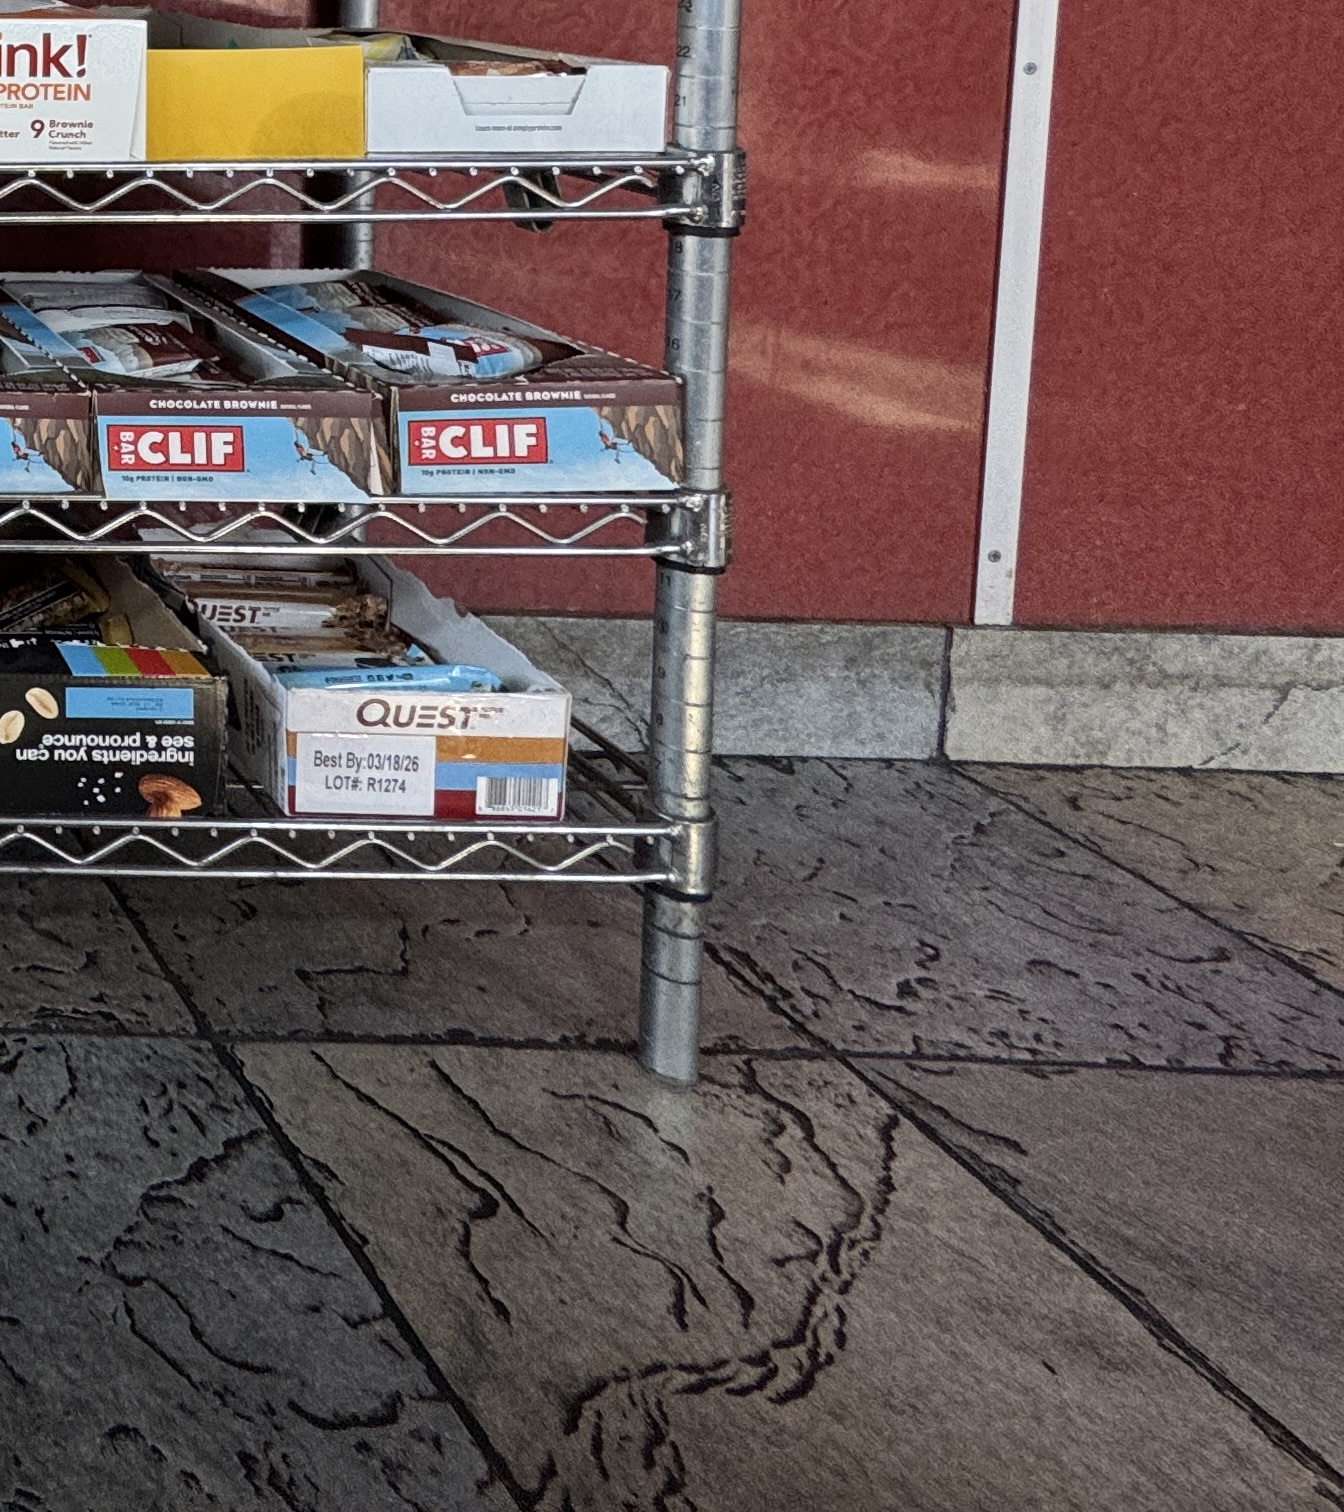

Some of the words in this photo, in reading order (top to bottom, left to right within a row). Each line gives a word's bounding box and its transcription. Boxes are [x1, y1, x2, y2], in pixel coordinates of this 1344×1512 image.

[677, 45, 690, 57] 22
[50, 120, 94, 129] Brownie
[49, 130, 86, 139] Crunch
[451, 392, 522, 403] CHOCOLATE
[525, 390, 582, 401] BROWNIE
[150, 400, 220, 409] CHOCOLATE
[224, 400, 278, 410] BROWNIE
[120, 432, 134, 464] BAR
[137, 432, 233, 465] CLIF
[421, 427, 436, 459] BAR
[439, 424, 537, 458] CLIF
[356, 698, 474, 730] QUEST
[43, 733, 140, 748] pronounce
[161, 734, 194, 746] see
[16, 748, 49, 761] can
[54, 748, 88, 762] you
[92, 749, 194, 766] ingredients
[314, 751, 342, 769] Best
[367, 777, 406, 793] R1274
